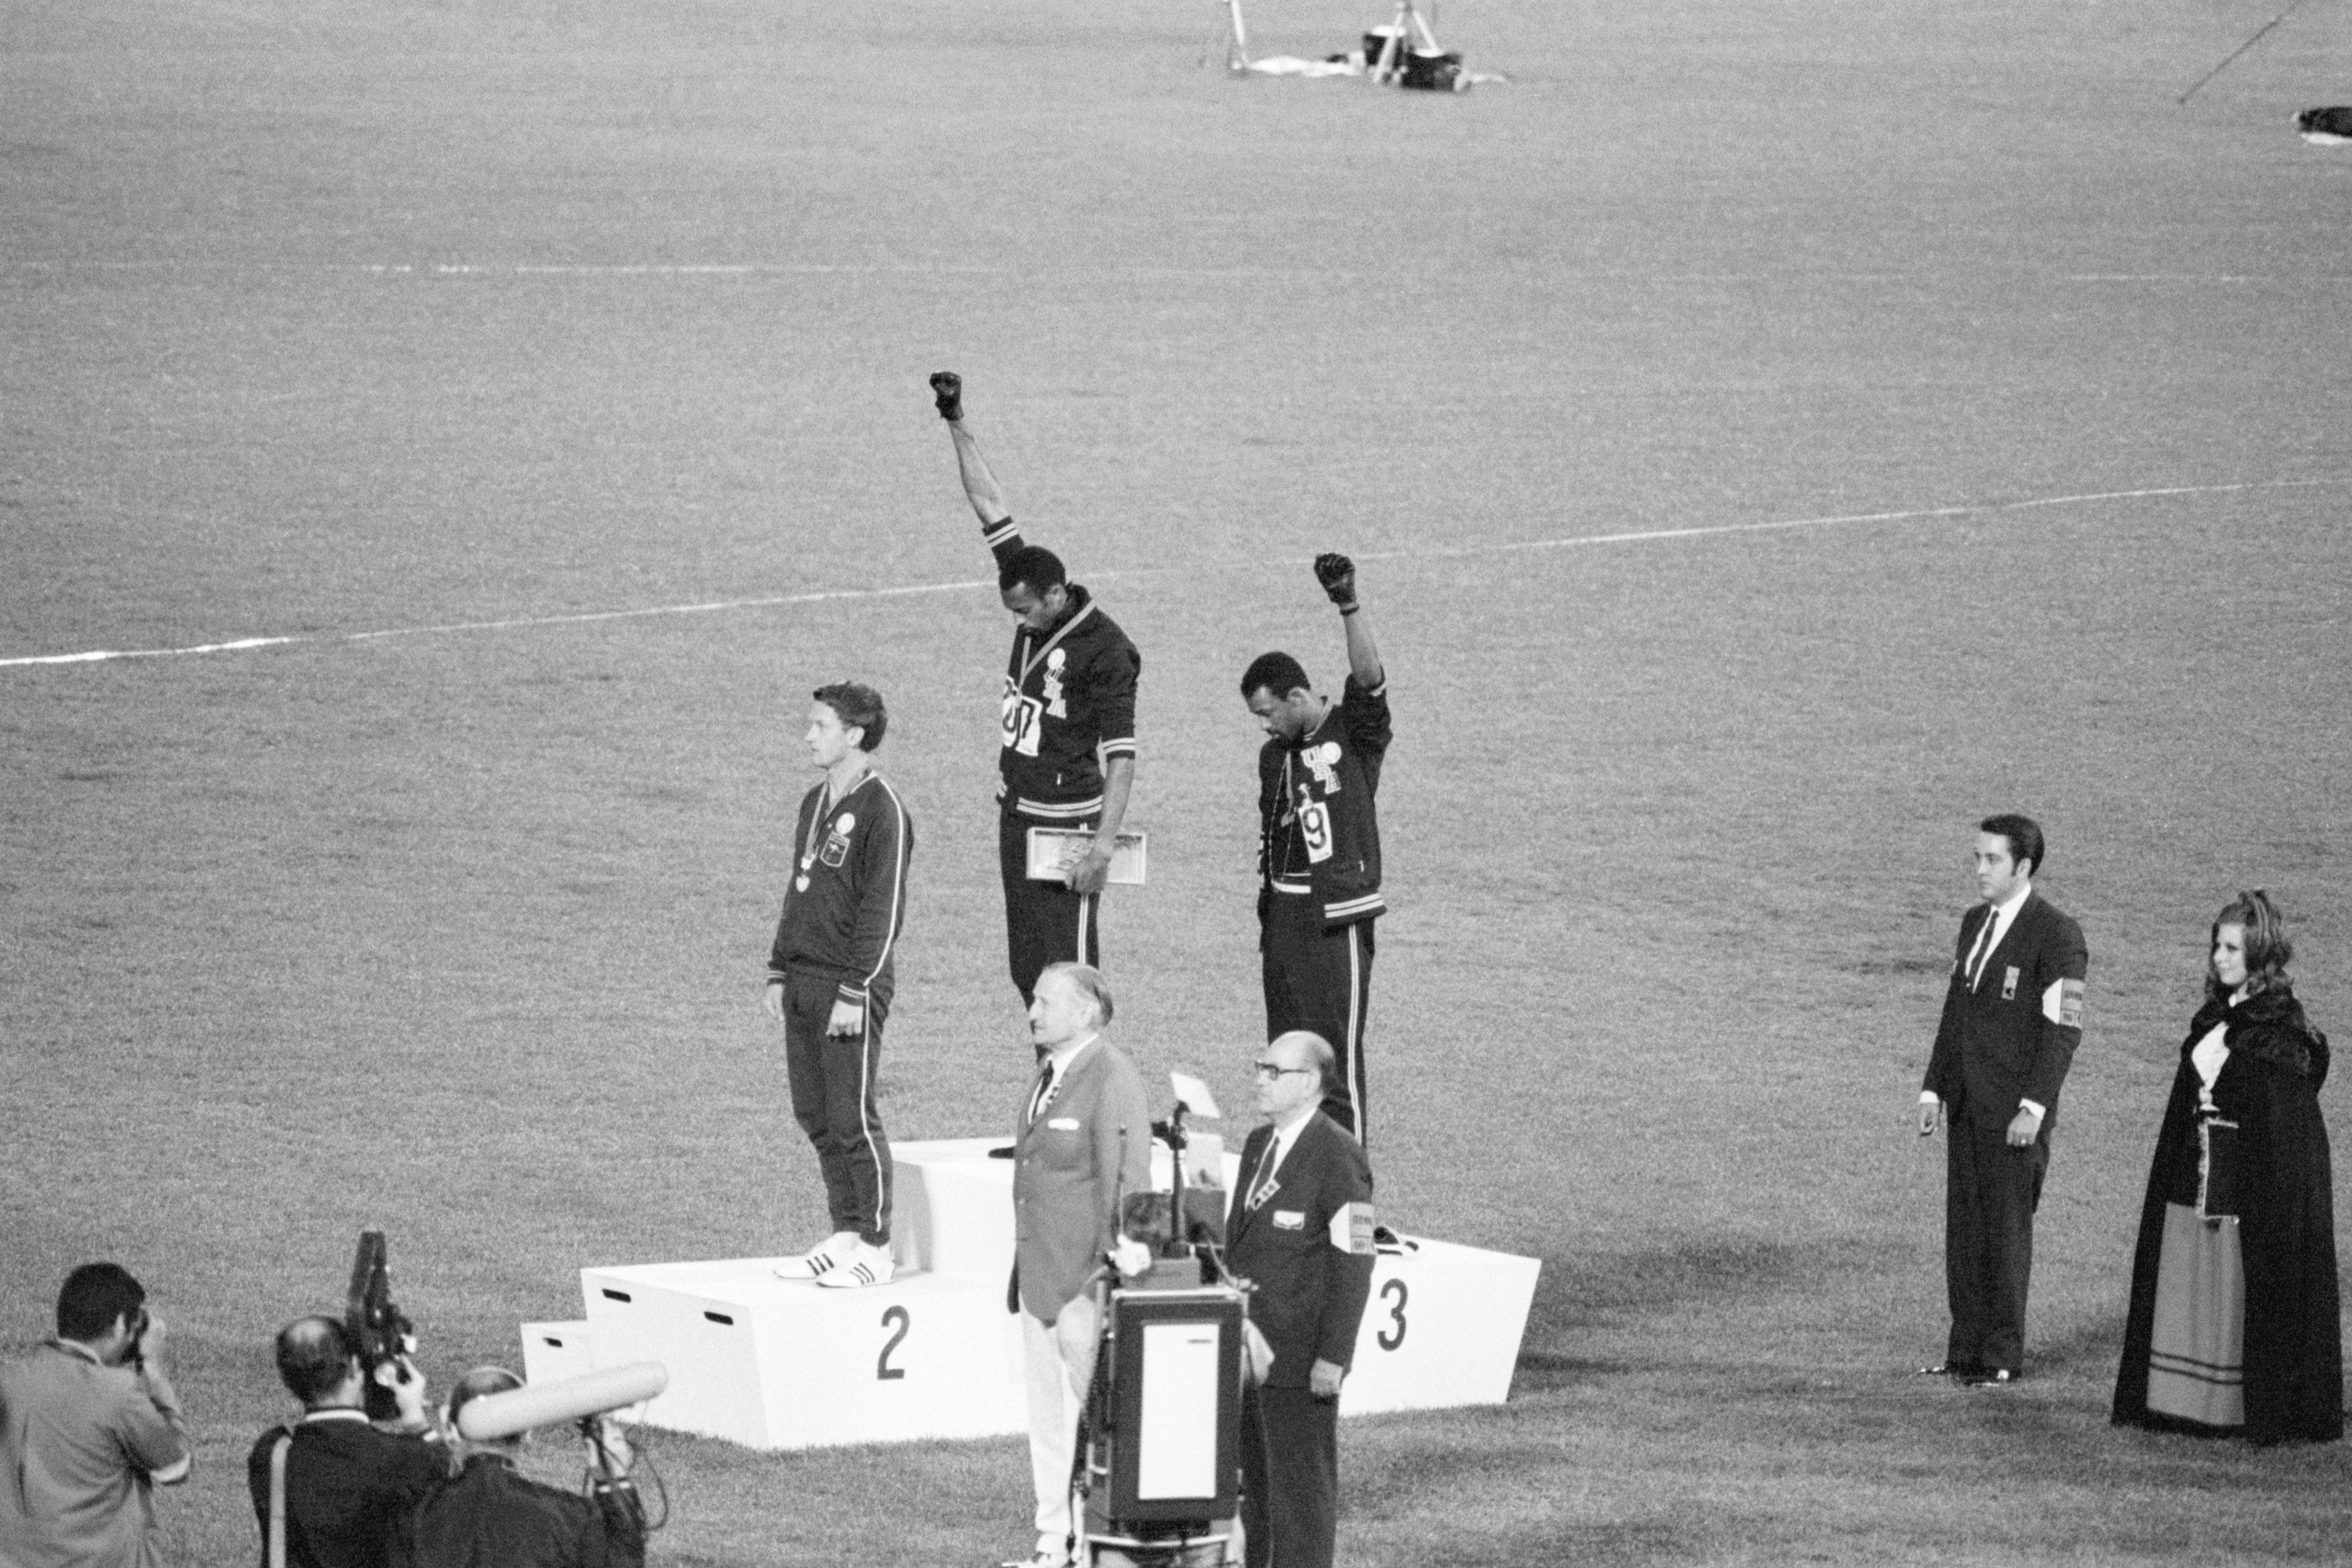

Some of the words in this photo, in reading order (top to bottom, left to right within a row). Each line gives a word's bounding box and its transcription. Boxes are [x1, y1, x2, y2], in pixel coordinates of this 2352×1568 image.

[1301, 745, 1341, 794] USA
[1302, 807, 1327, 850] 9
[877, 1305, 910, 1381] 2
[1377, 1278, 1408, 1352] 3
